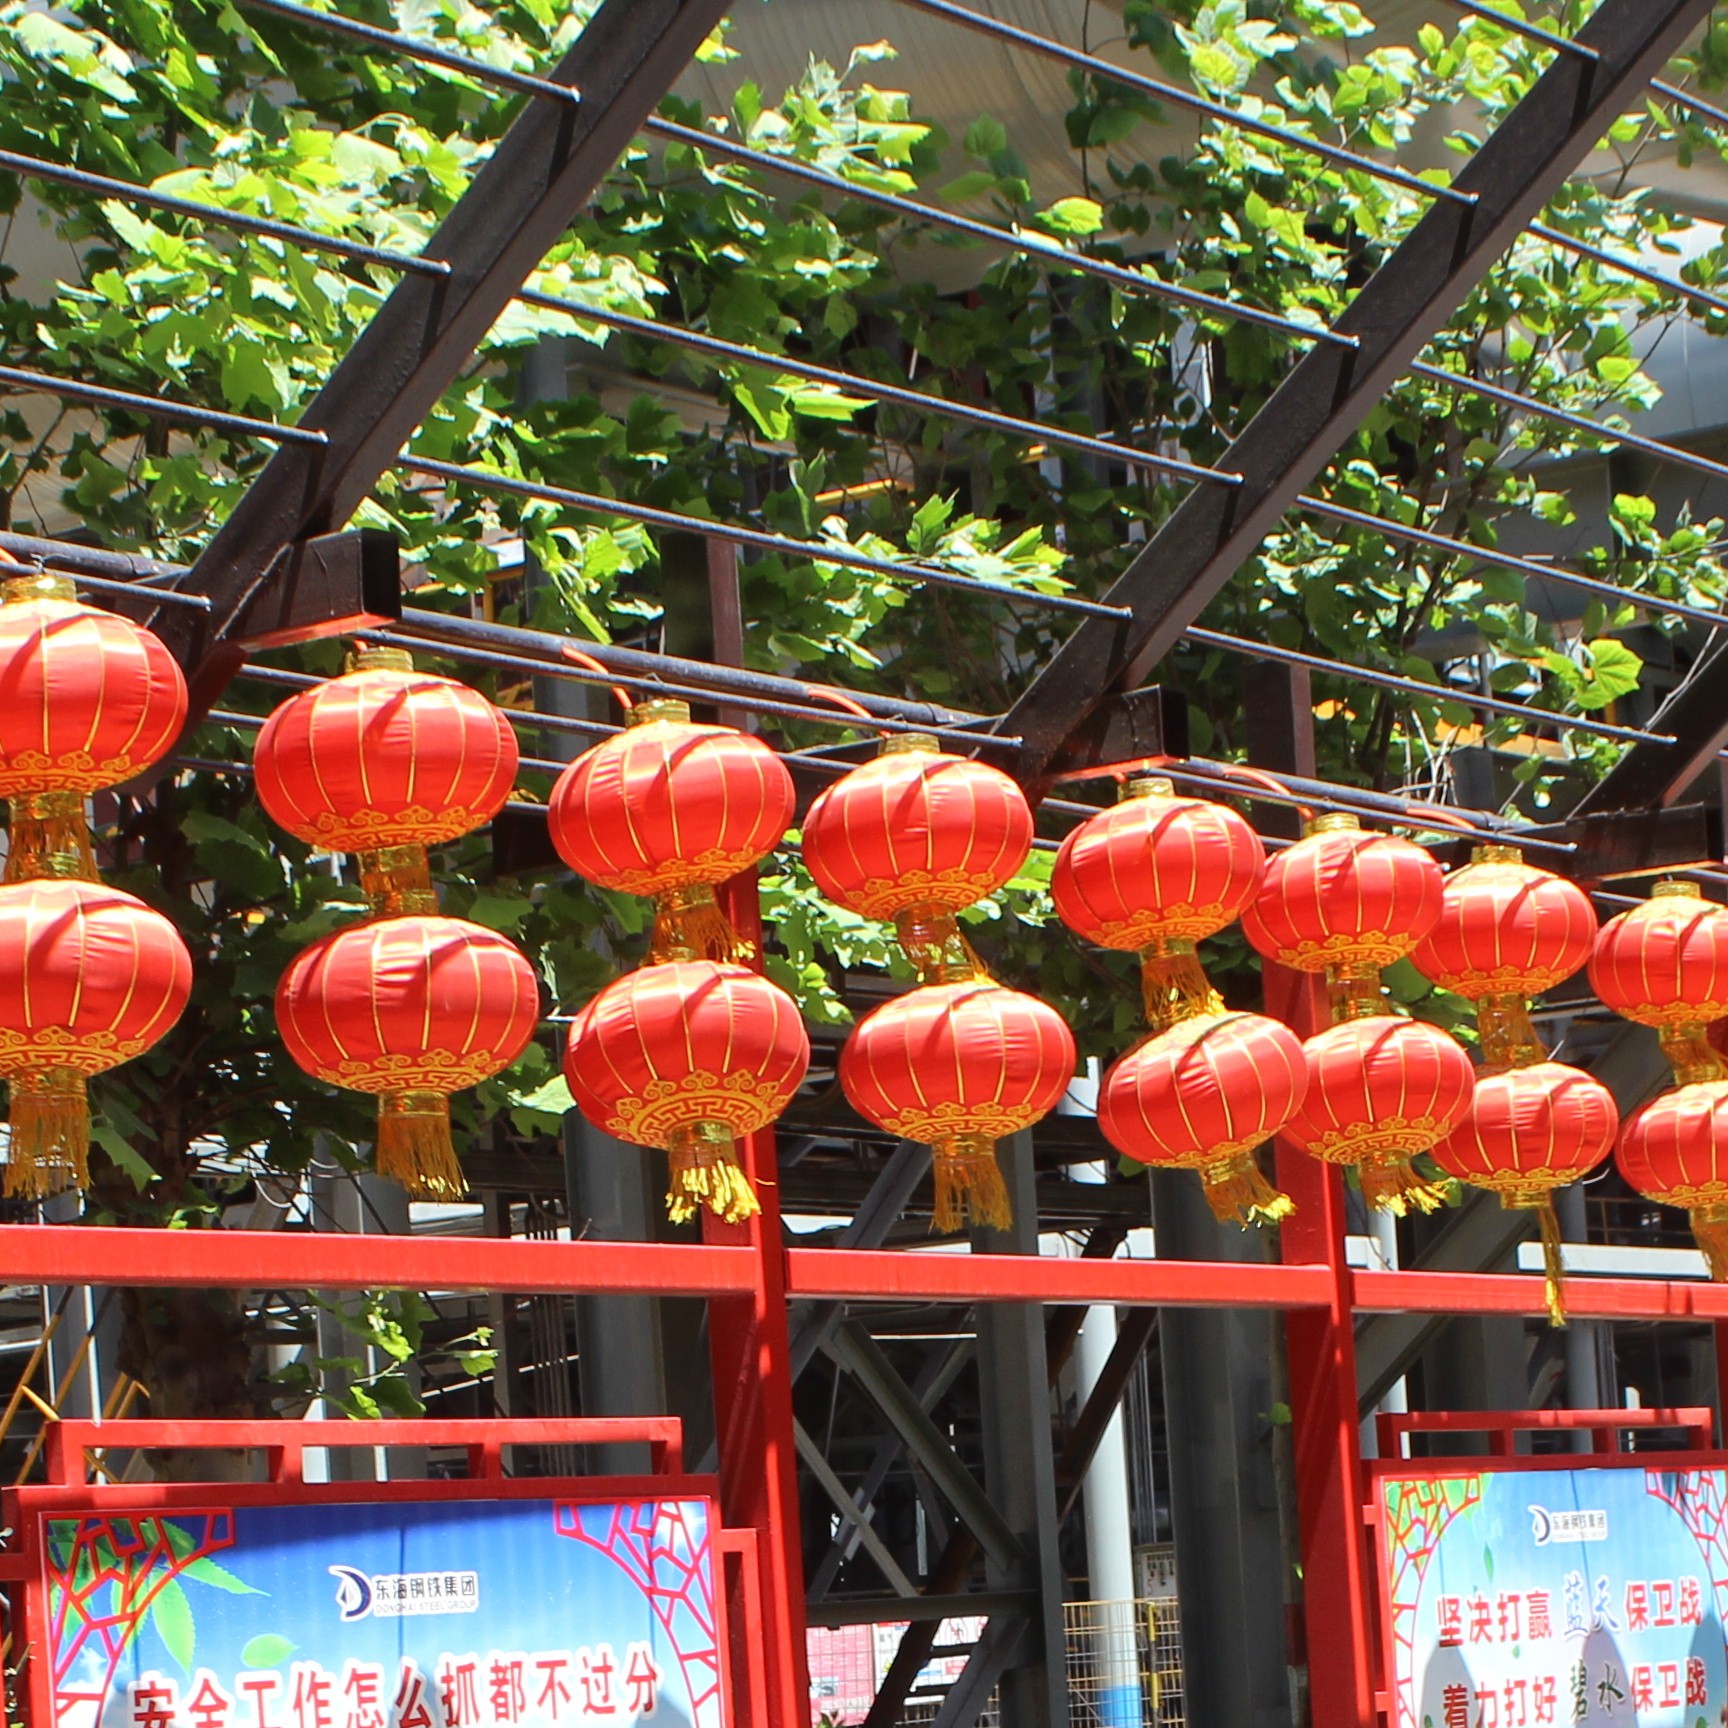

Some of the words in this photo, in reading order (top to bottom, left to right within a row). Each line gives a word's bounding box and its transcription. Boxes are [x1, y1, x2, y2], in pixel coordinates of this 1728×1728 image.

[375, 1575, 476, 1600] 东海钢铁集团
